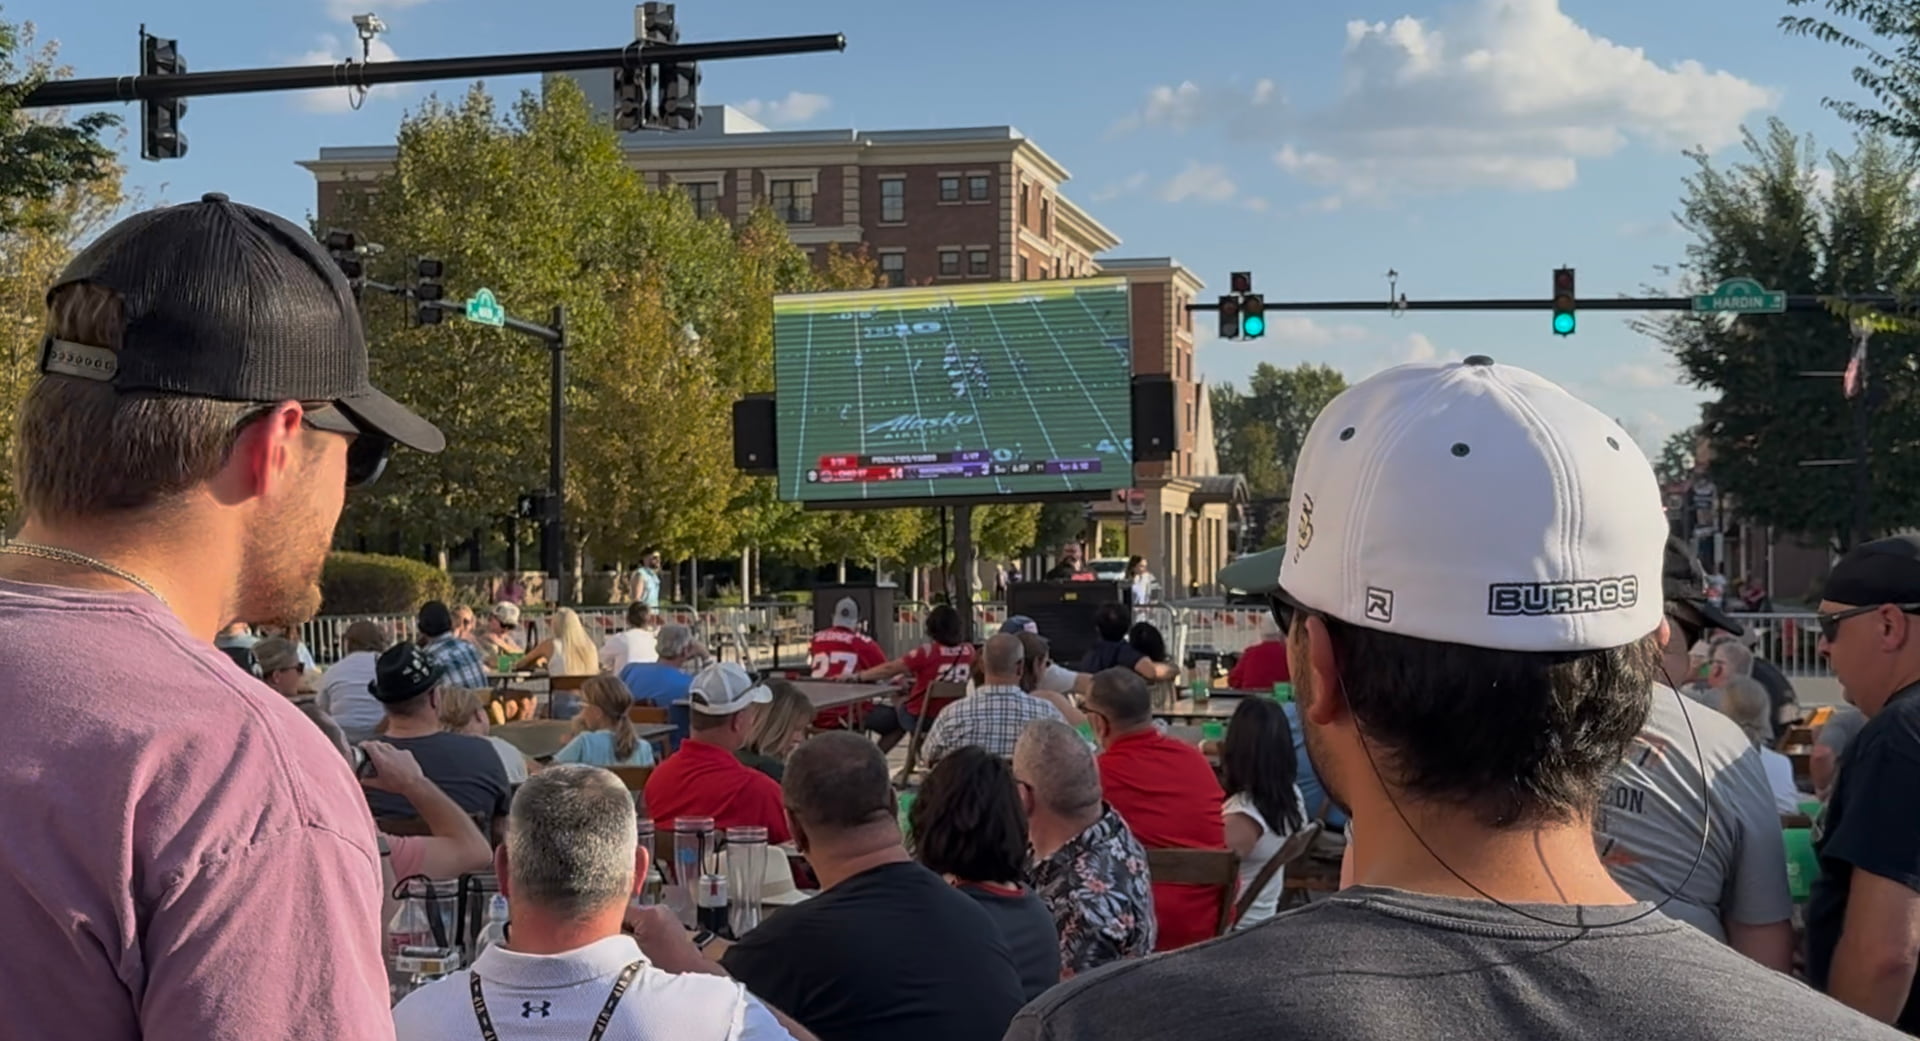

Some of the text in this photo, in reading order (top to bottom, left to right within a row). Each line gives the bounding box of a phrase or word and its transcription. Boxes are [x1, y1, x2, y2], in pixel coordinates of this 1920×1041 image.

[1713, 296, 1763, 309] HARDIN
[1488, 576, 1638, 616] BURROS
[811, 651, 858, 680] 27
[1609, 786, 1644, 814] ON
